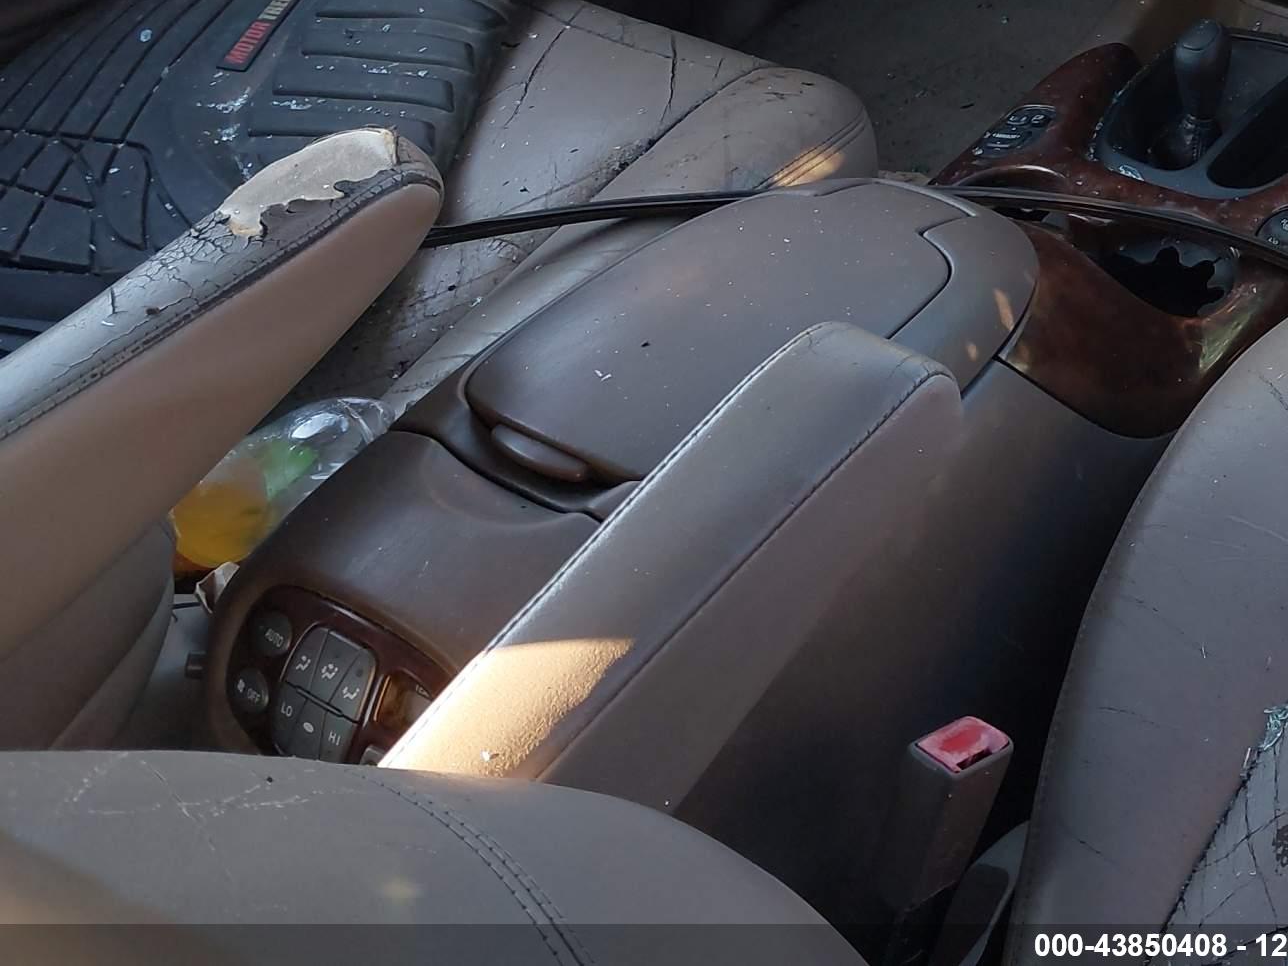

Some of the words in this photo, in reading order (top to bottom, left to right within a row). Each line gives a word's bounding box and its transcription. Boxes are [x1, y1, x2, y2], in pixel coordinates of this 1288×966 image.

[224, 21, 271, 64] MOTOR
[264, 628, 285, 648] AUTO
[280, 701, 293, 718] LO
[327, 730, 341, 747] HI
